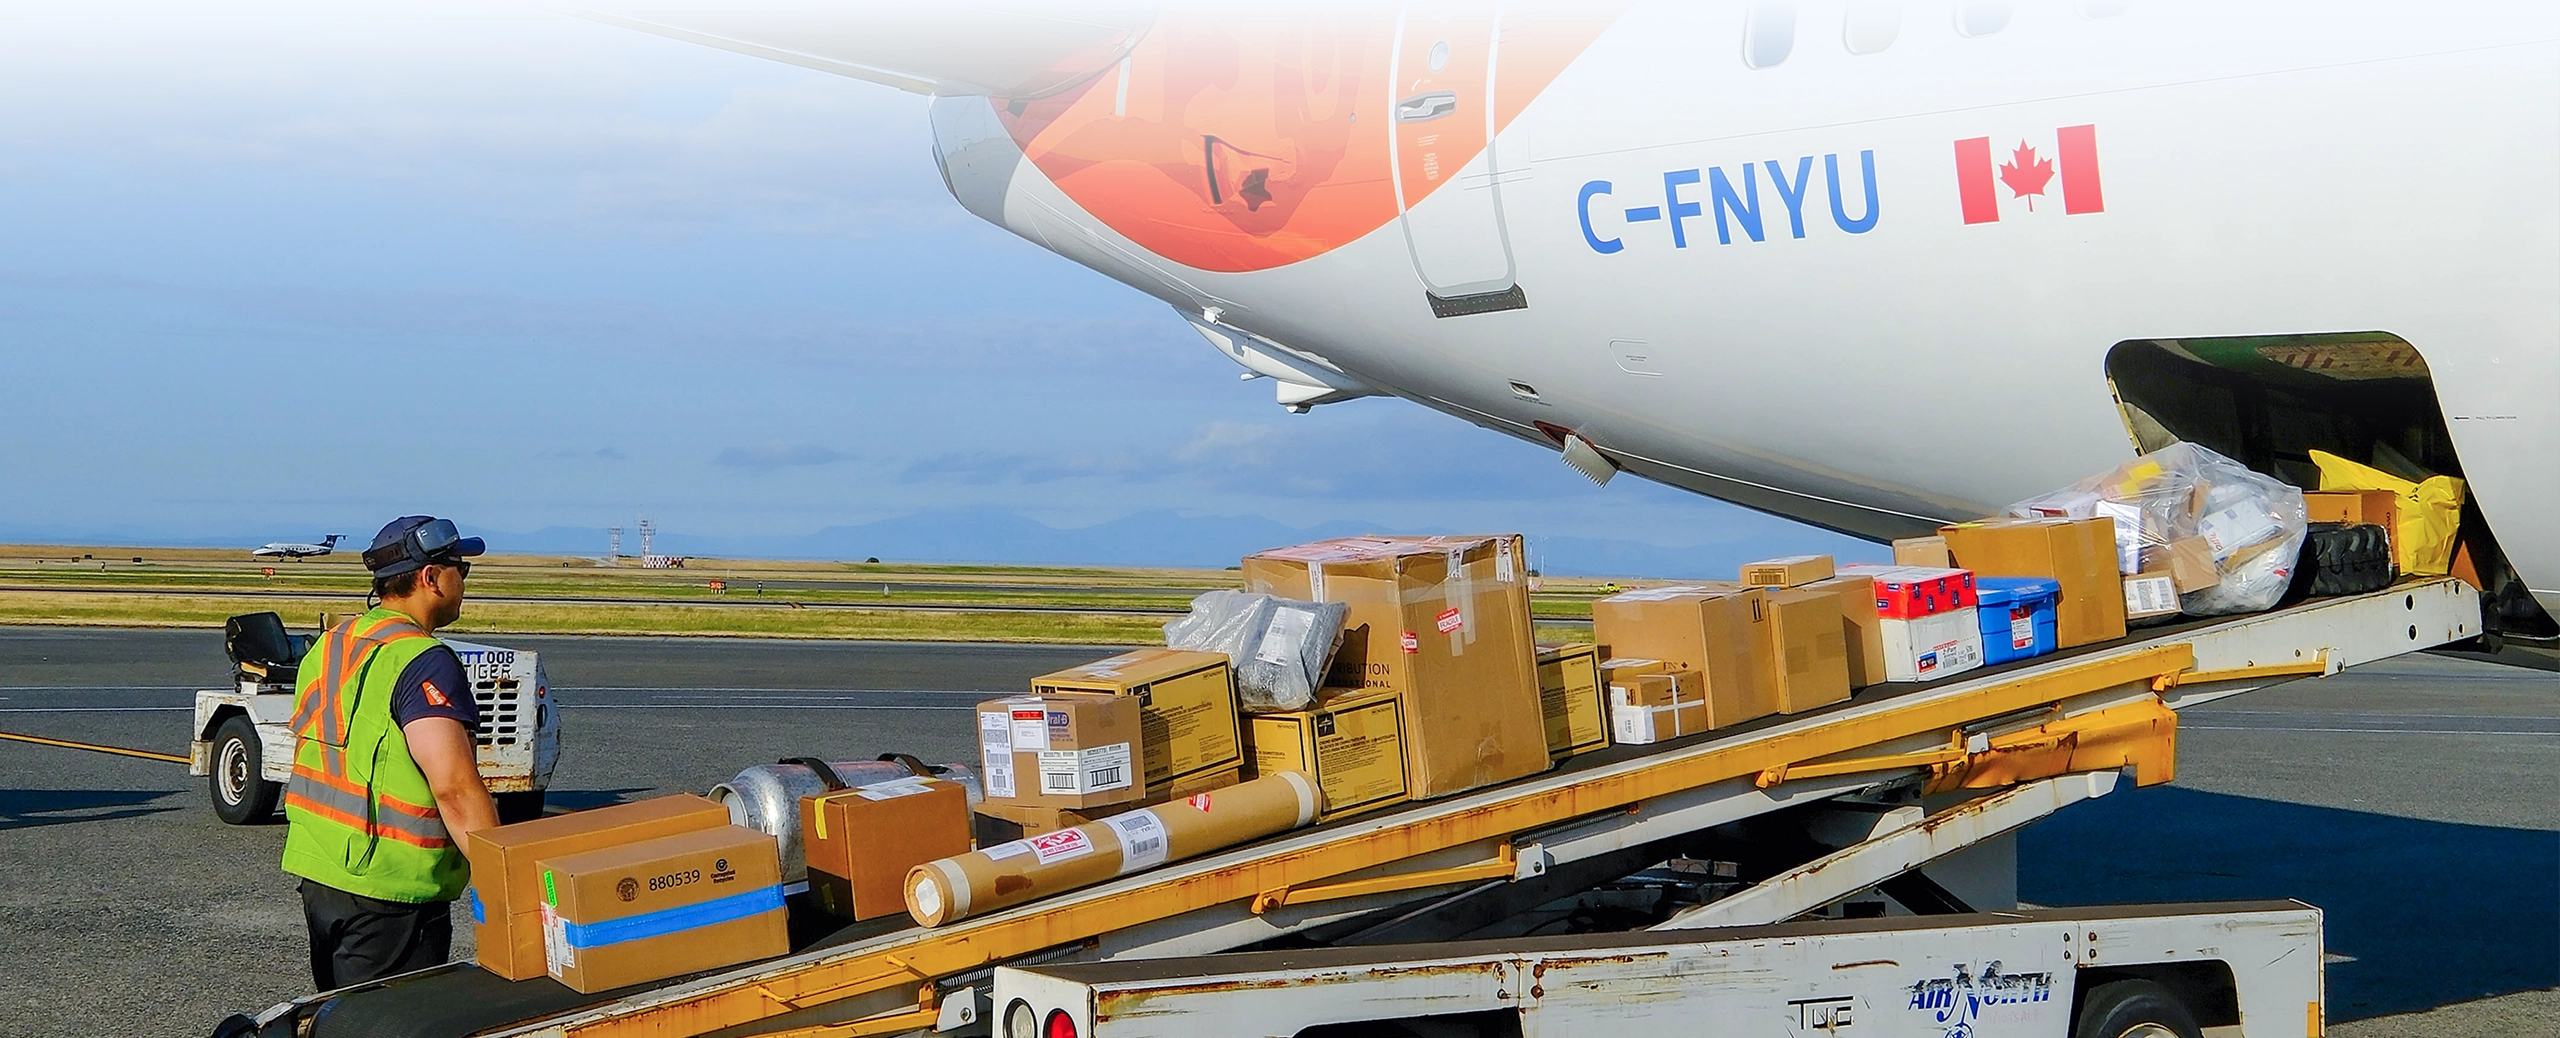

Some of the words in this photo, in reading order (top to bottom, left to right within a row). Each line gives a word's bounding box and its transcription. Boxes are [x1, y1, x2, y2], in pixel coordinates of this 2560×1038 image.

[1577, 149, 1880, 255] C-FNYU
[1440, 616, 1459, 629] FRAGILE
[486, 651, 515, 664] 008
[465, 665, 512, 679] TIGER
[1336, 663, 1390, 675] RIBUTION
[648, 869, 701, 891] 880539
